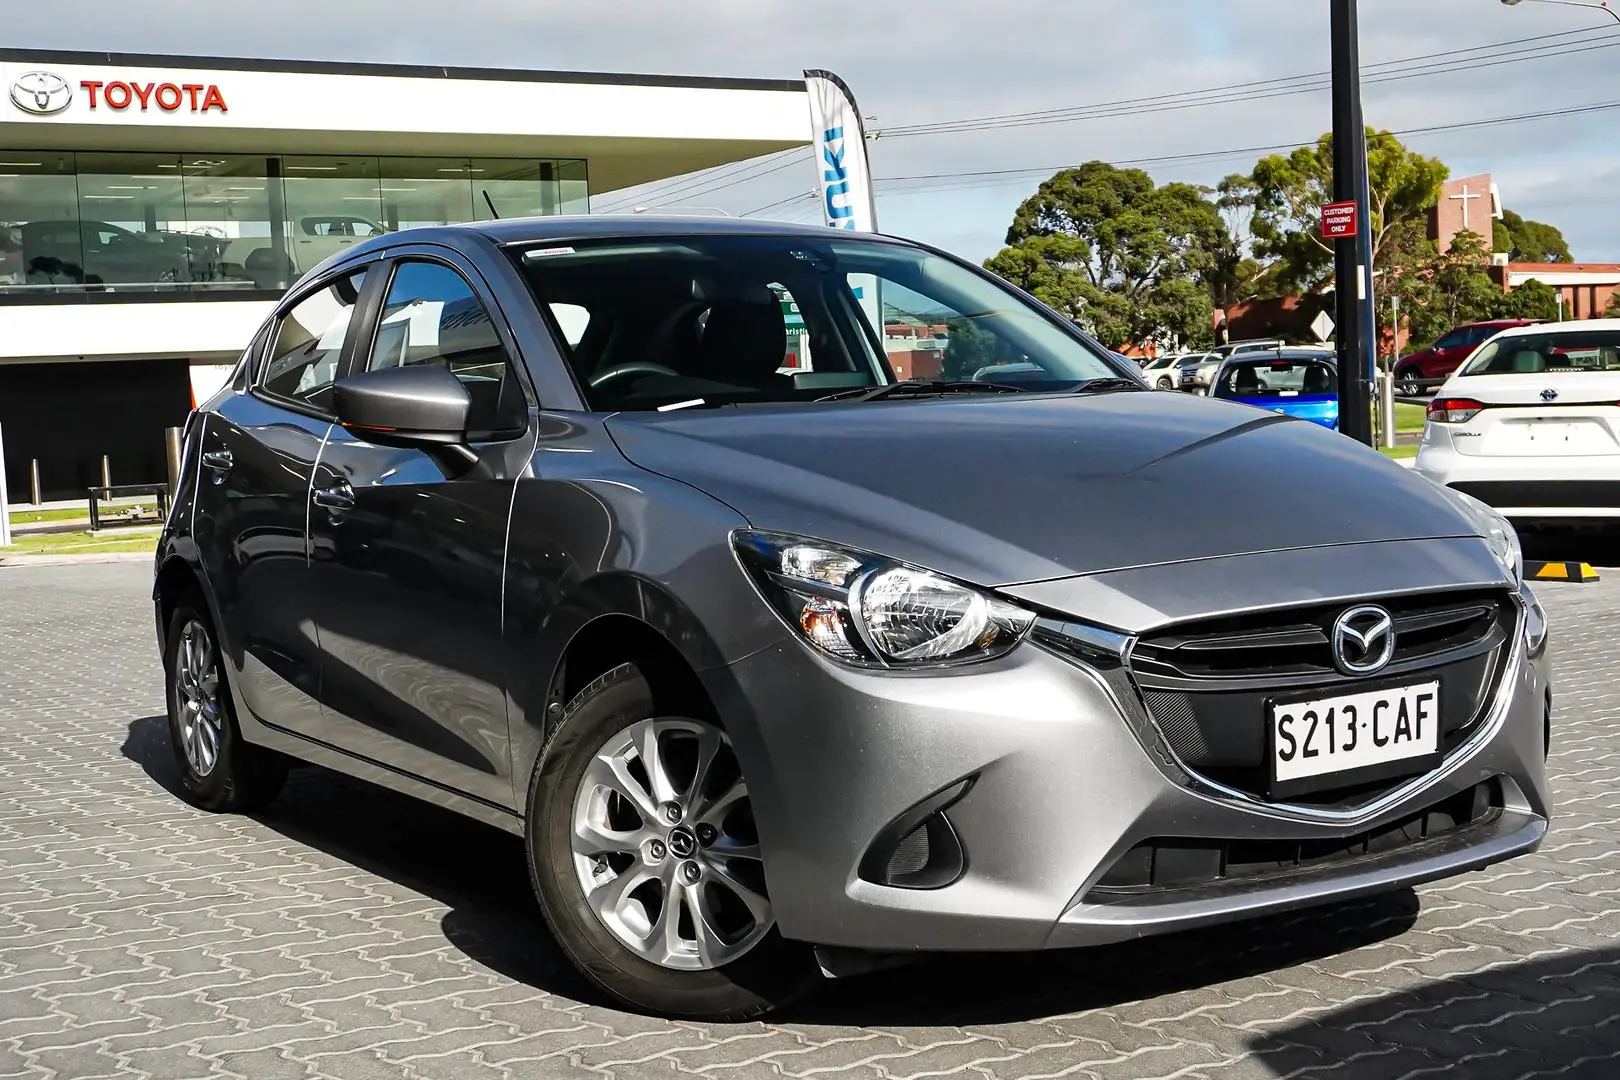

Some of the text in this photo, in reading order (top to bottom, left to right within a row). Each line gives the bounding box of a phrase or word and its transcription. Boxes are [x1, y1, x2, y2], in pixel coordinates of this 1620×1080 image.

[80, 80, 228, 112] TOYOTA
[1324, 207, 1354, 216] CUSTOMER
[1326, 216, 1351, 224] PARKING
[1331, 225, 1346, 233] ONLY
